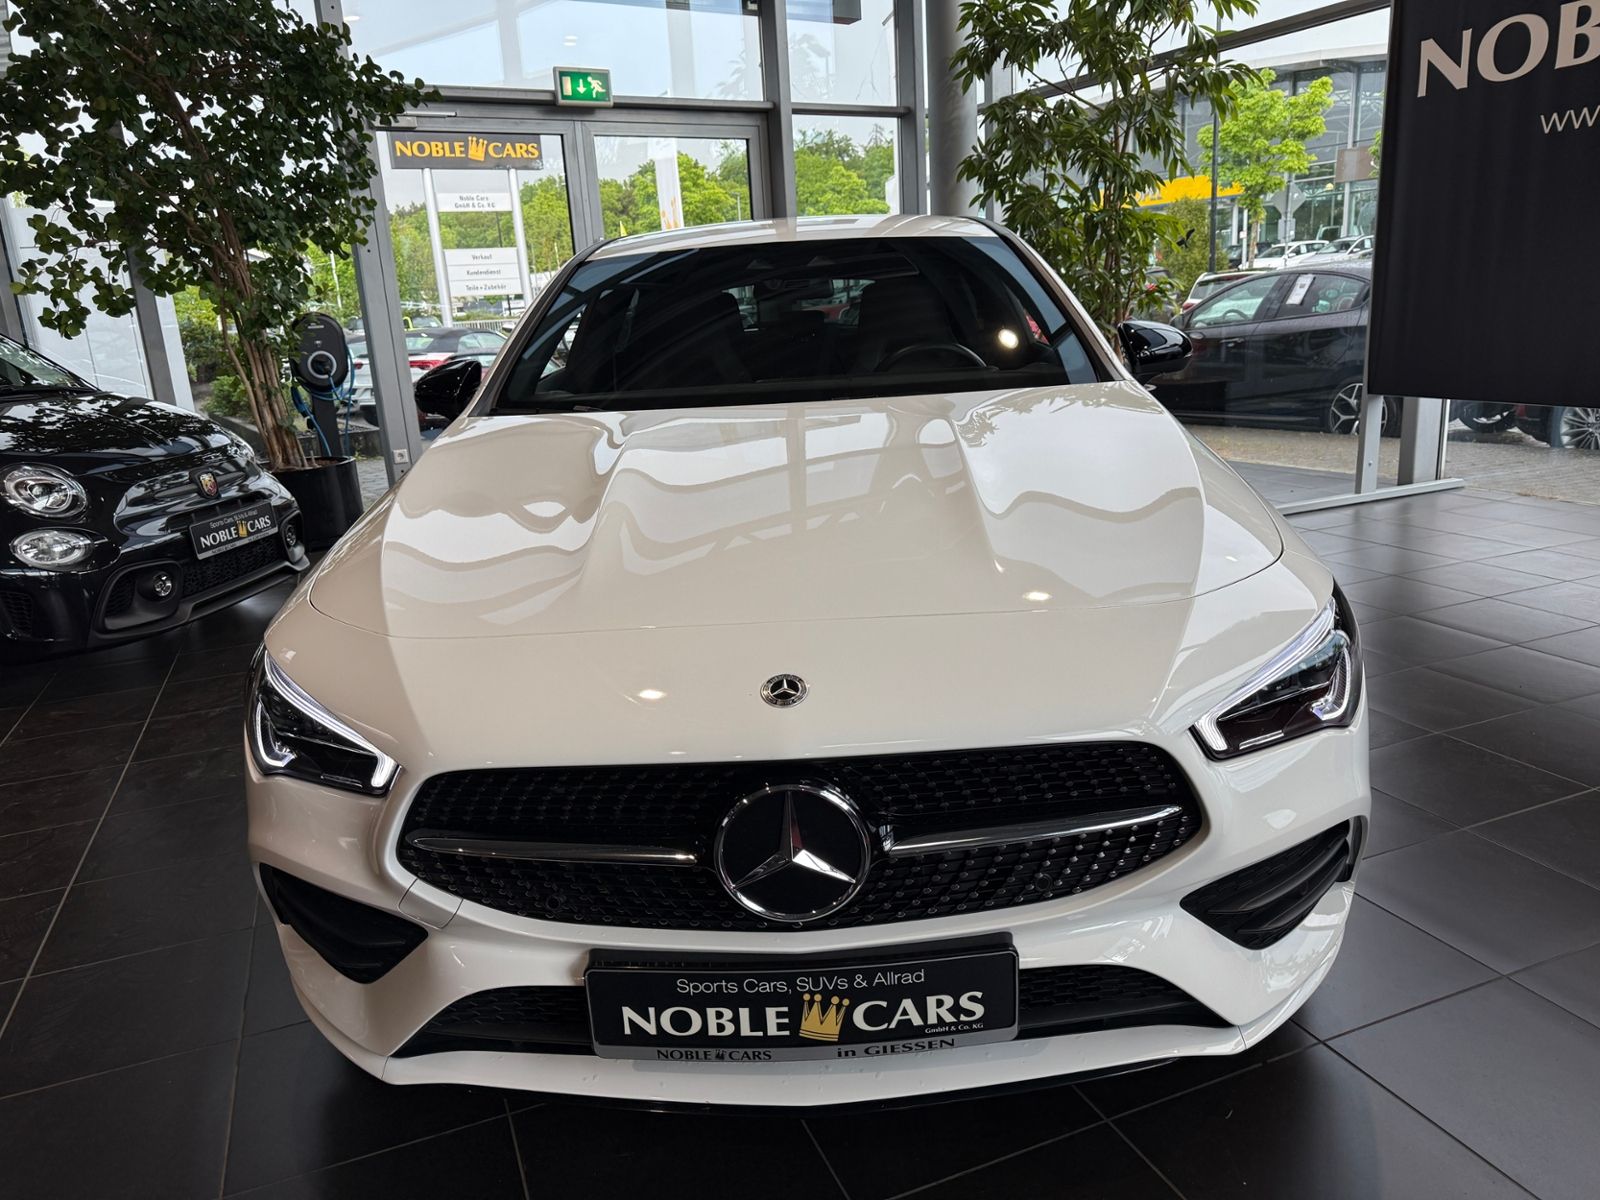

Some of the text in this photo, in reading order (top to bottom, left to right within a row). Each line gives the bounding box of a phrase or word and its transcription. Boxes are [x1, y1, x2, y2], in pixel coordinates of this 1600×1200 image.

[395, 140, 539, 159] NOBLE CARS
[200, 527, 238, 548] NOBLE
[247, 515, 271, 532] CARS
[676, 968, 925, 996] Sports Cars, SUVs & Allrad
[621, 990, 985, 1037] NOBLE CARS
[925, 1026, 949, 1034] GmbH
[972, 1022, 984, 1030] KG
[656, 1048, 773, 1061] NOBLE CARS
[837, 1038, 955, 1058] in GIESSEN
